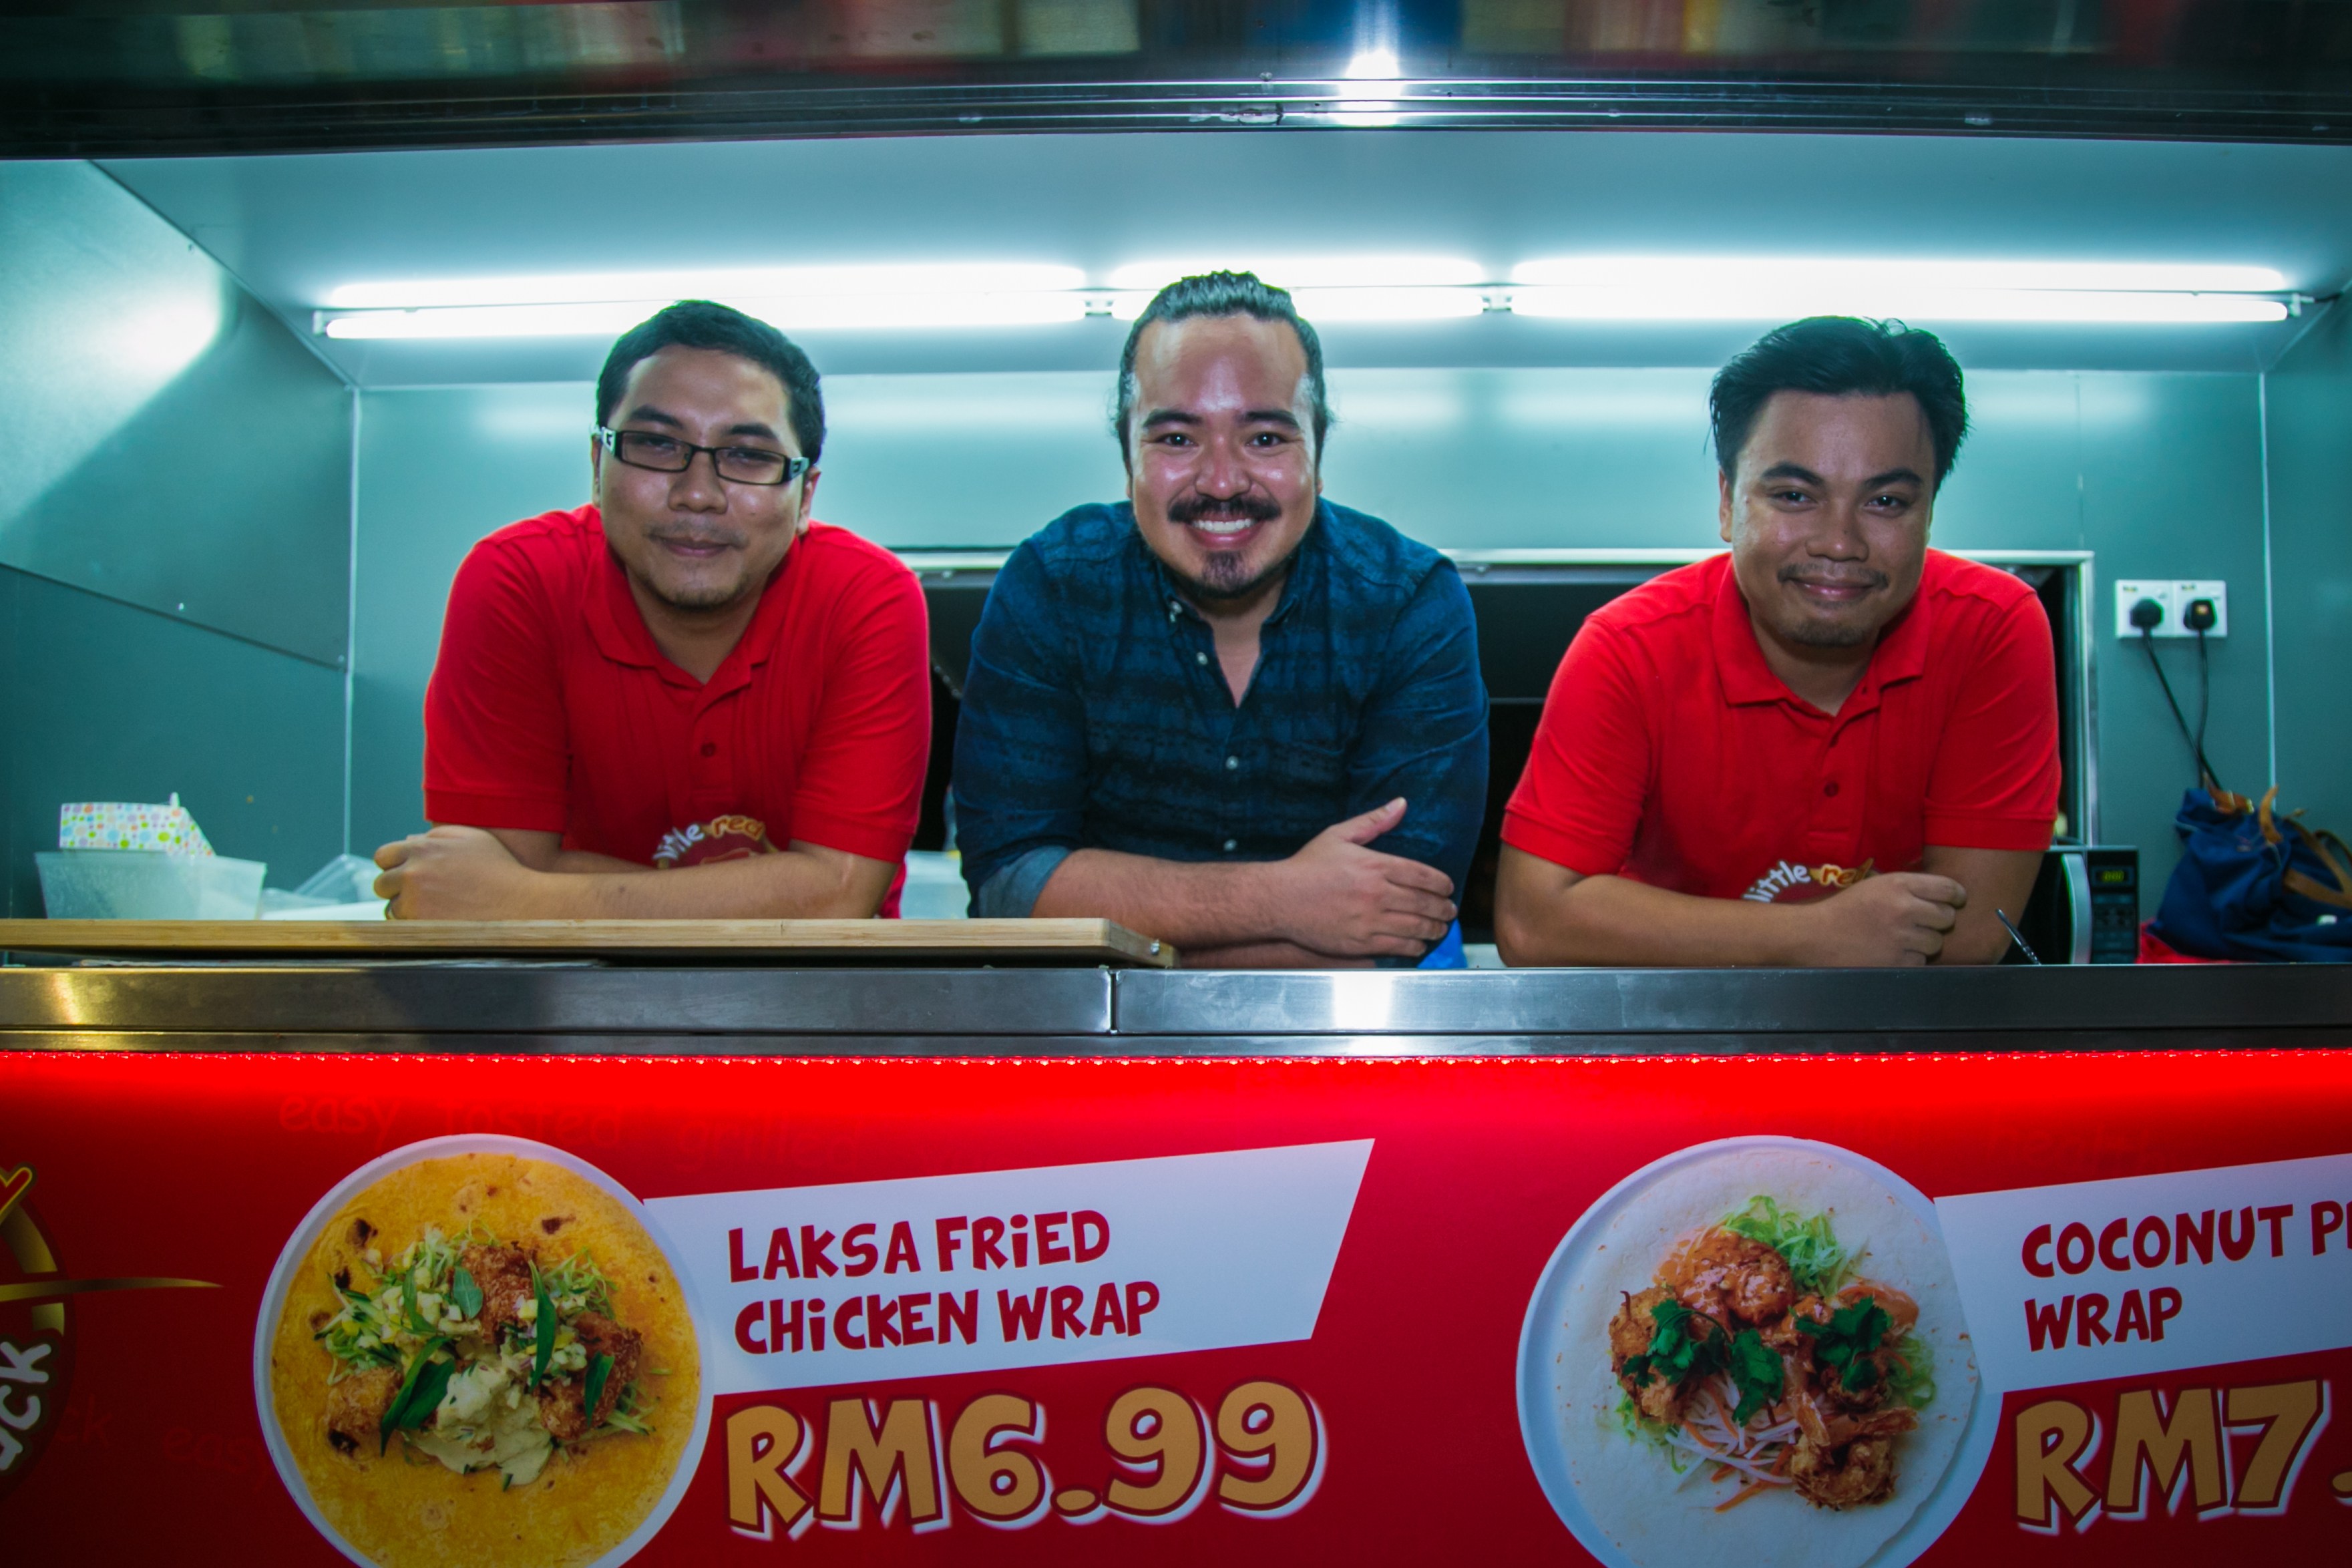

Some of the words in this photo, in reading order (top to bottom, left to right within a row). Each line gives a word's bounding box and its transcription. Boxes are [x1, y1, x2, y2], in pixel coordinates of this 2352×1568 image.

[1742, 859, 1811, 904] little
[729, 1221, 921, 1282] LAKSA
[2022, 1204, 2293, 1278] COCONUT
[998, 1282, 1159, 1342] WRAP
[2025, 1287, 2182, 1352] WRAP
[724, 1379, 1327, 1540] RM6.99
